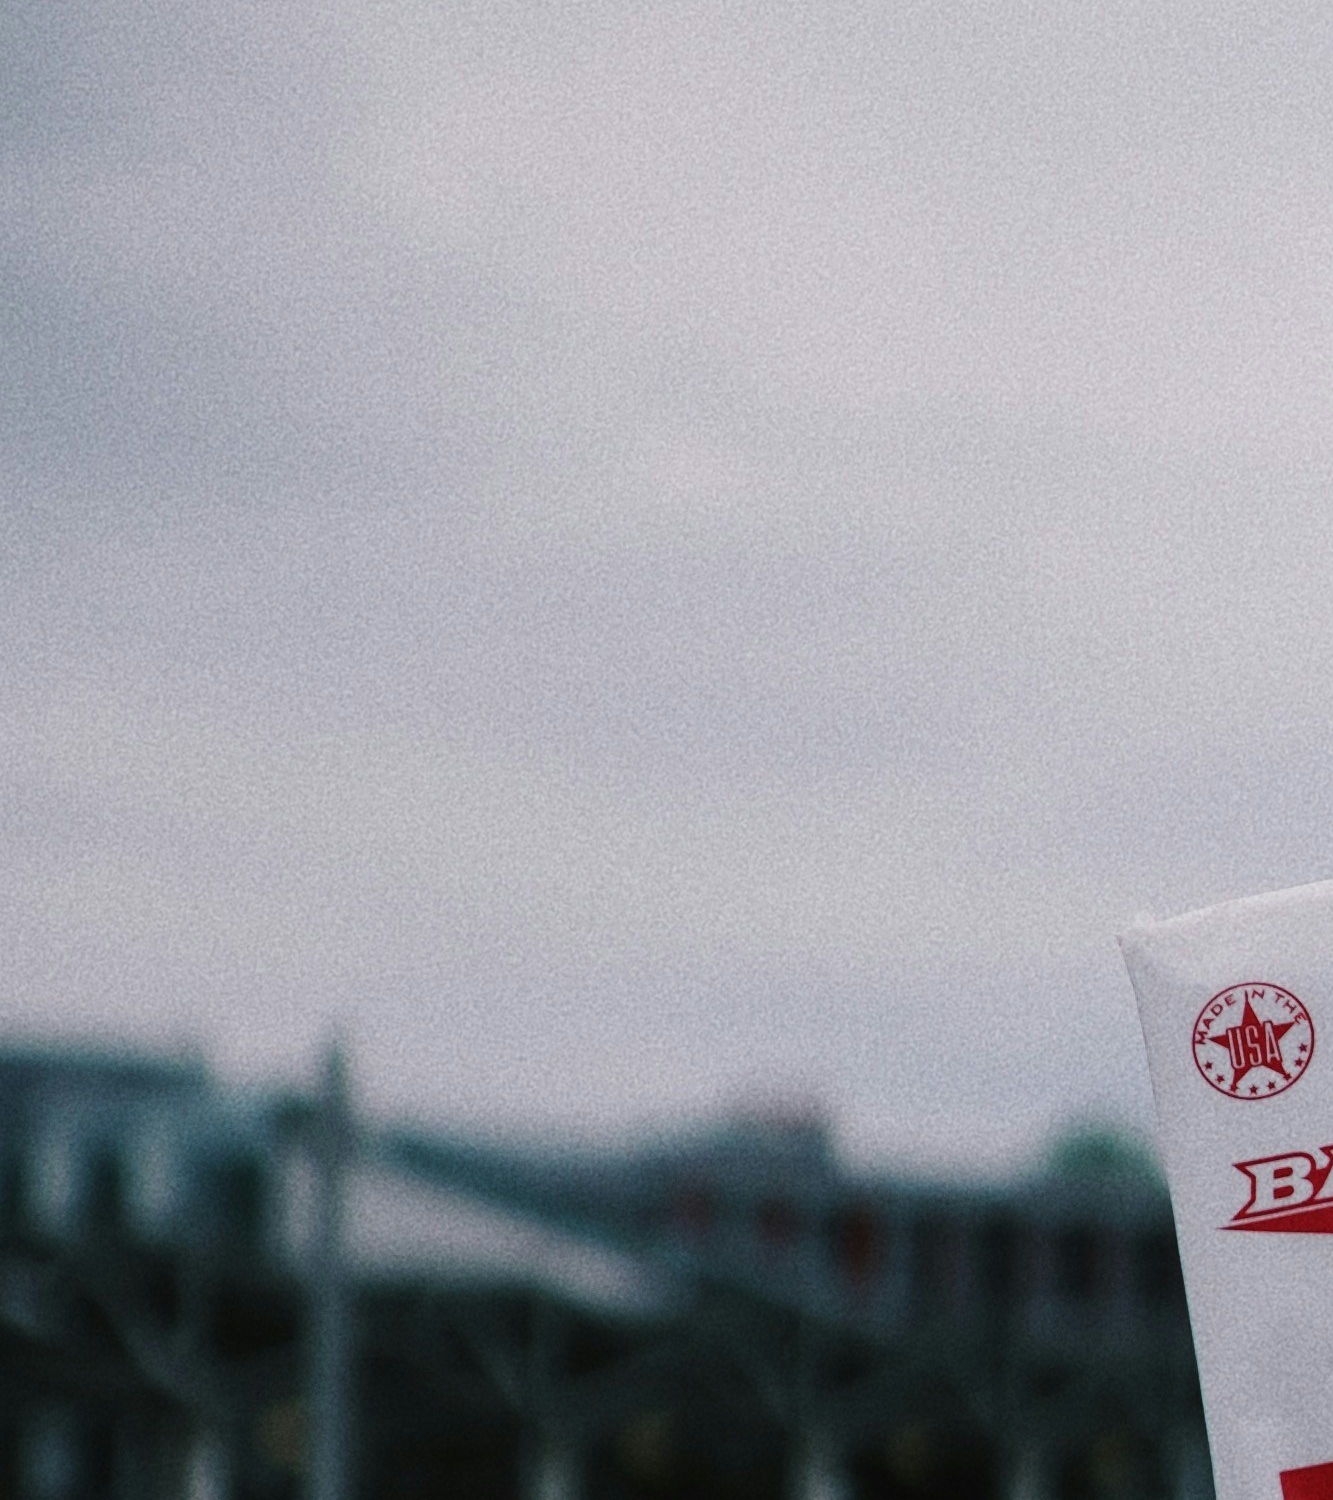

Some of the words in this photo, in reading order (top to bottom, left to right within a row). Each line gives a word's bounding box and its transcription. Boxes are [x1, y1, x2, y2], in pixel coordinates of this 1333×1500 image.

[1195, 993, 1237, 1045] MADE
[1243, 989, 1266, 1001] IN
[1273, 991, 1307, 1025] THE
[1226, 1020, 1282, 1069] USA
